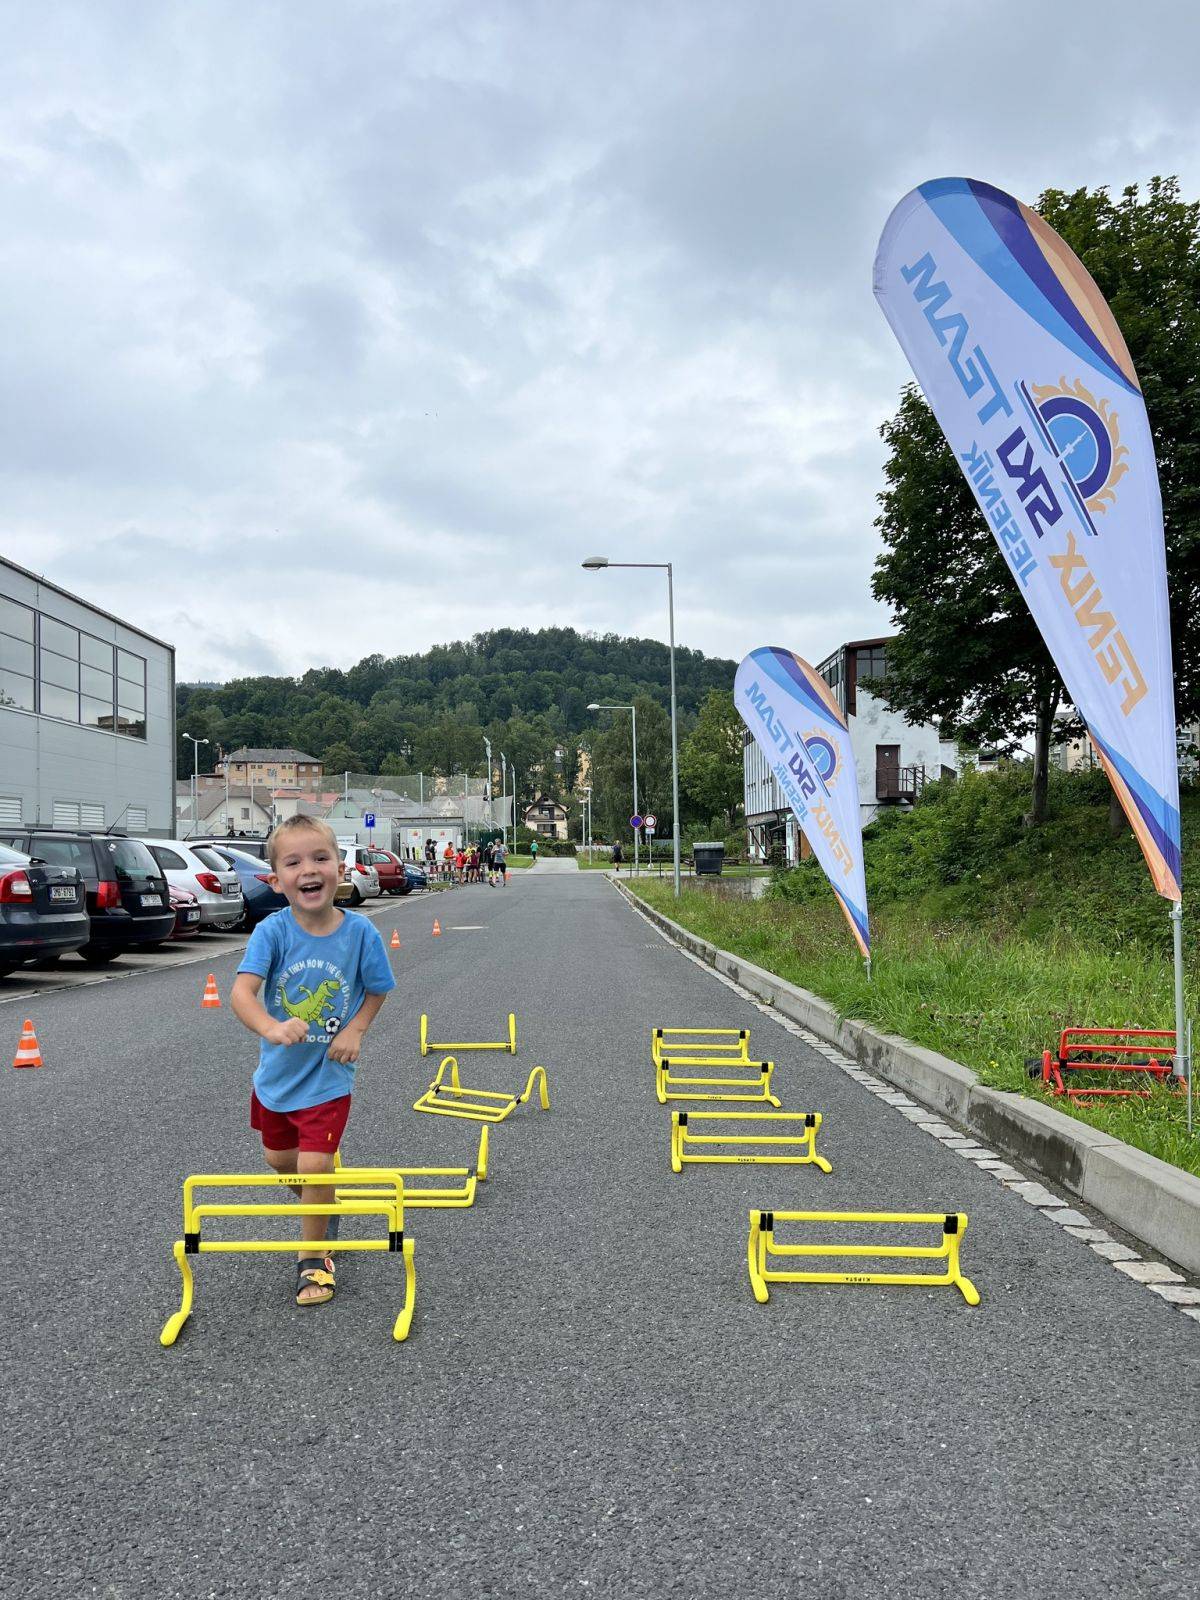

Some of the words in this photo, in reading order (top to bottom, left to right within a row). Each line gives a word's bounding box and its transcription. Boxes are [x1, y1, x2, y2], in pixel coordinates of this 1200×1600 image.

[288, 960, 306, 975] THEM
[306, 958, 324, 969] HOW
[325, 961, 338, 975] THE
